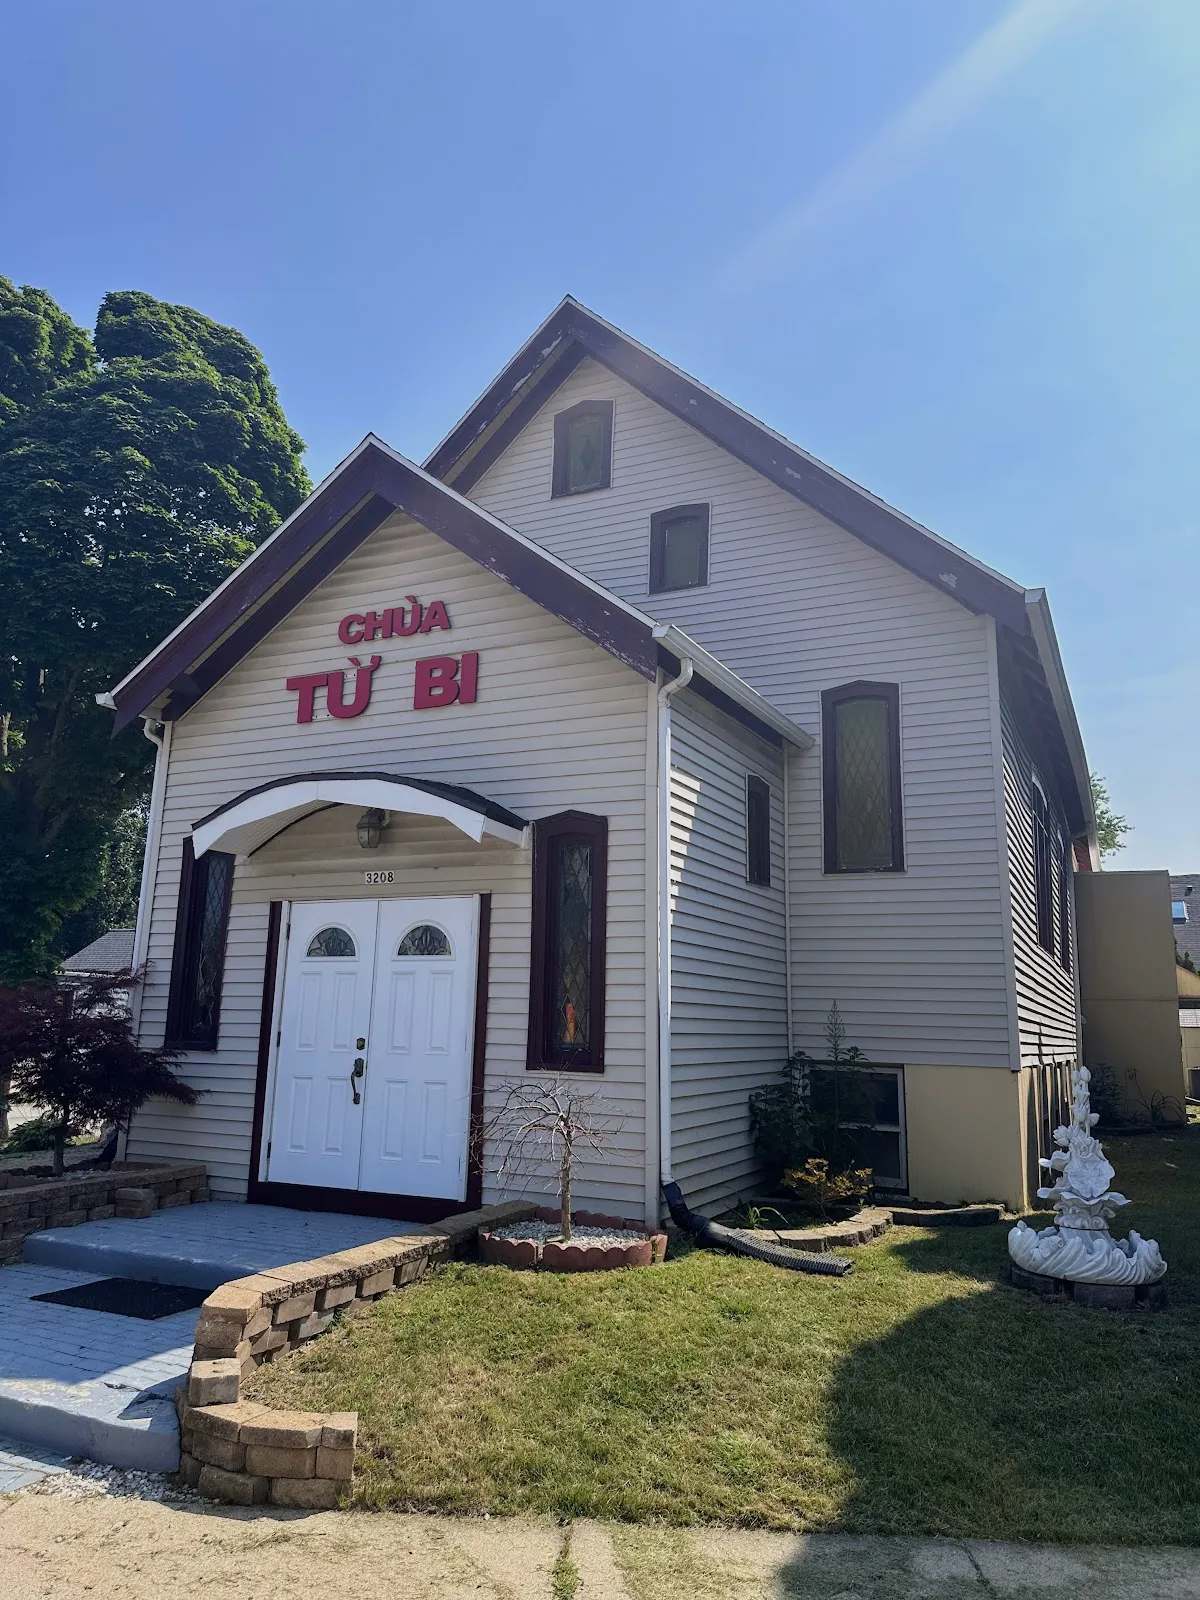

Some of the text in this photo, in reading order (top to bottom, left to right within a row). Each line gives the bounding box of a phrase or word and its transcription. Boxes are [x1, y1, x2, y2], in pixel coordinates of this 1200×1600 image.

[338, 595, 451, 644] CHÙA
[286, 651, 479, 724] TỪ BI
[365, 871, 394, 884] 3208
